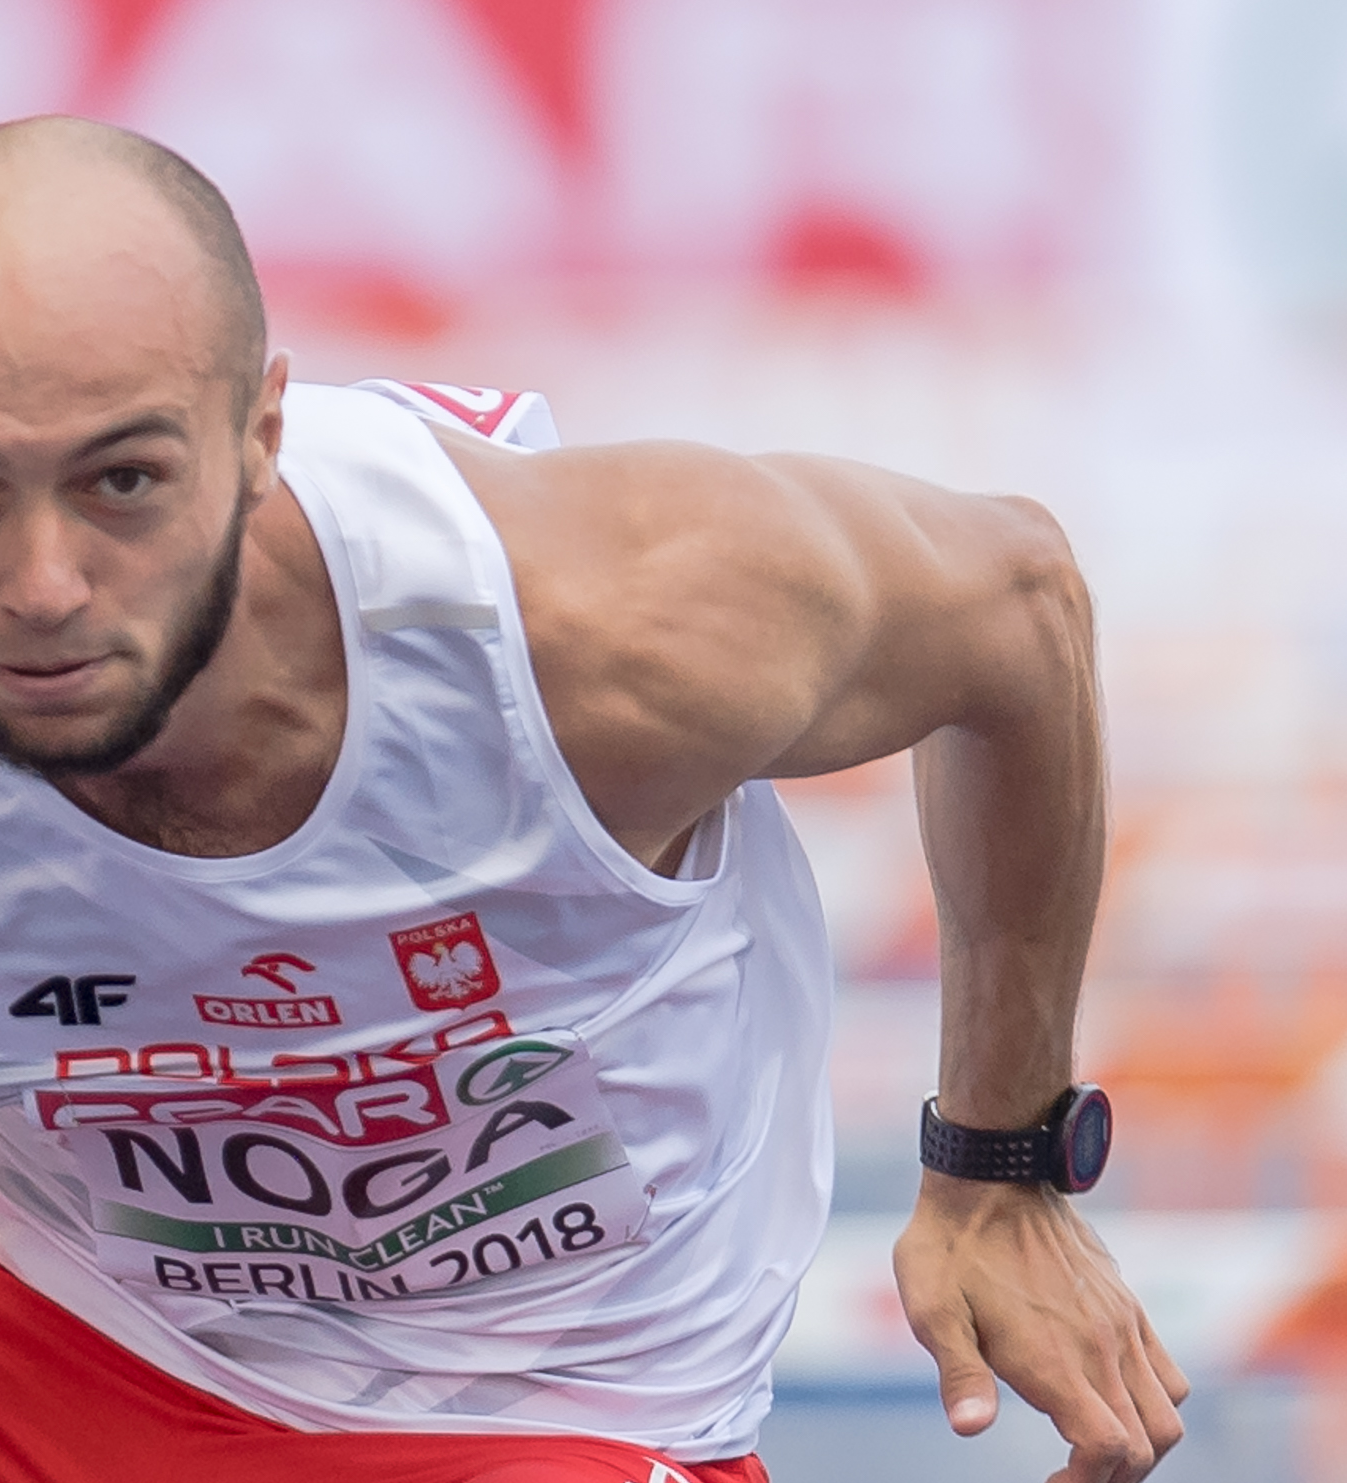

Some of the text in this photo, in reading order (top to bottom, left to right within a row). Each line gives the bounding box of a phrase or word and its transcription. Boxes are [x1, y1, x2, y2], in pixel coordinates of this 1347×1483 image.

[396, 918, 472, 946] POLSKA
[9, 974, 136, 1026] 4F
[205, 999, 330, 1025] ORLEN
[103, 1100, 575, 1218] NOGA
[155, 1202, 605, 1302] BERLIN 2018
[213, 1227, 225, 1248] I
[240, 1226, 337, 1259] RUN
